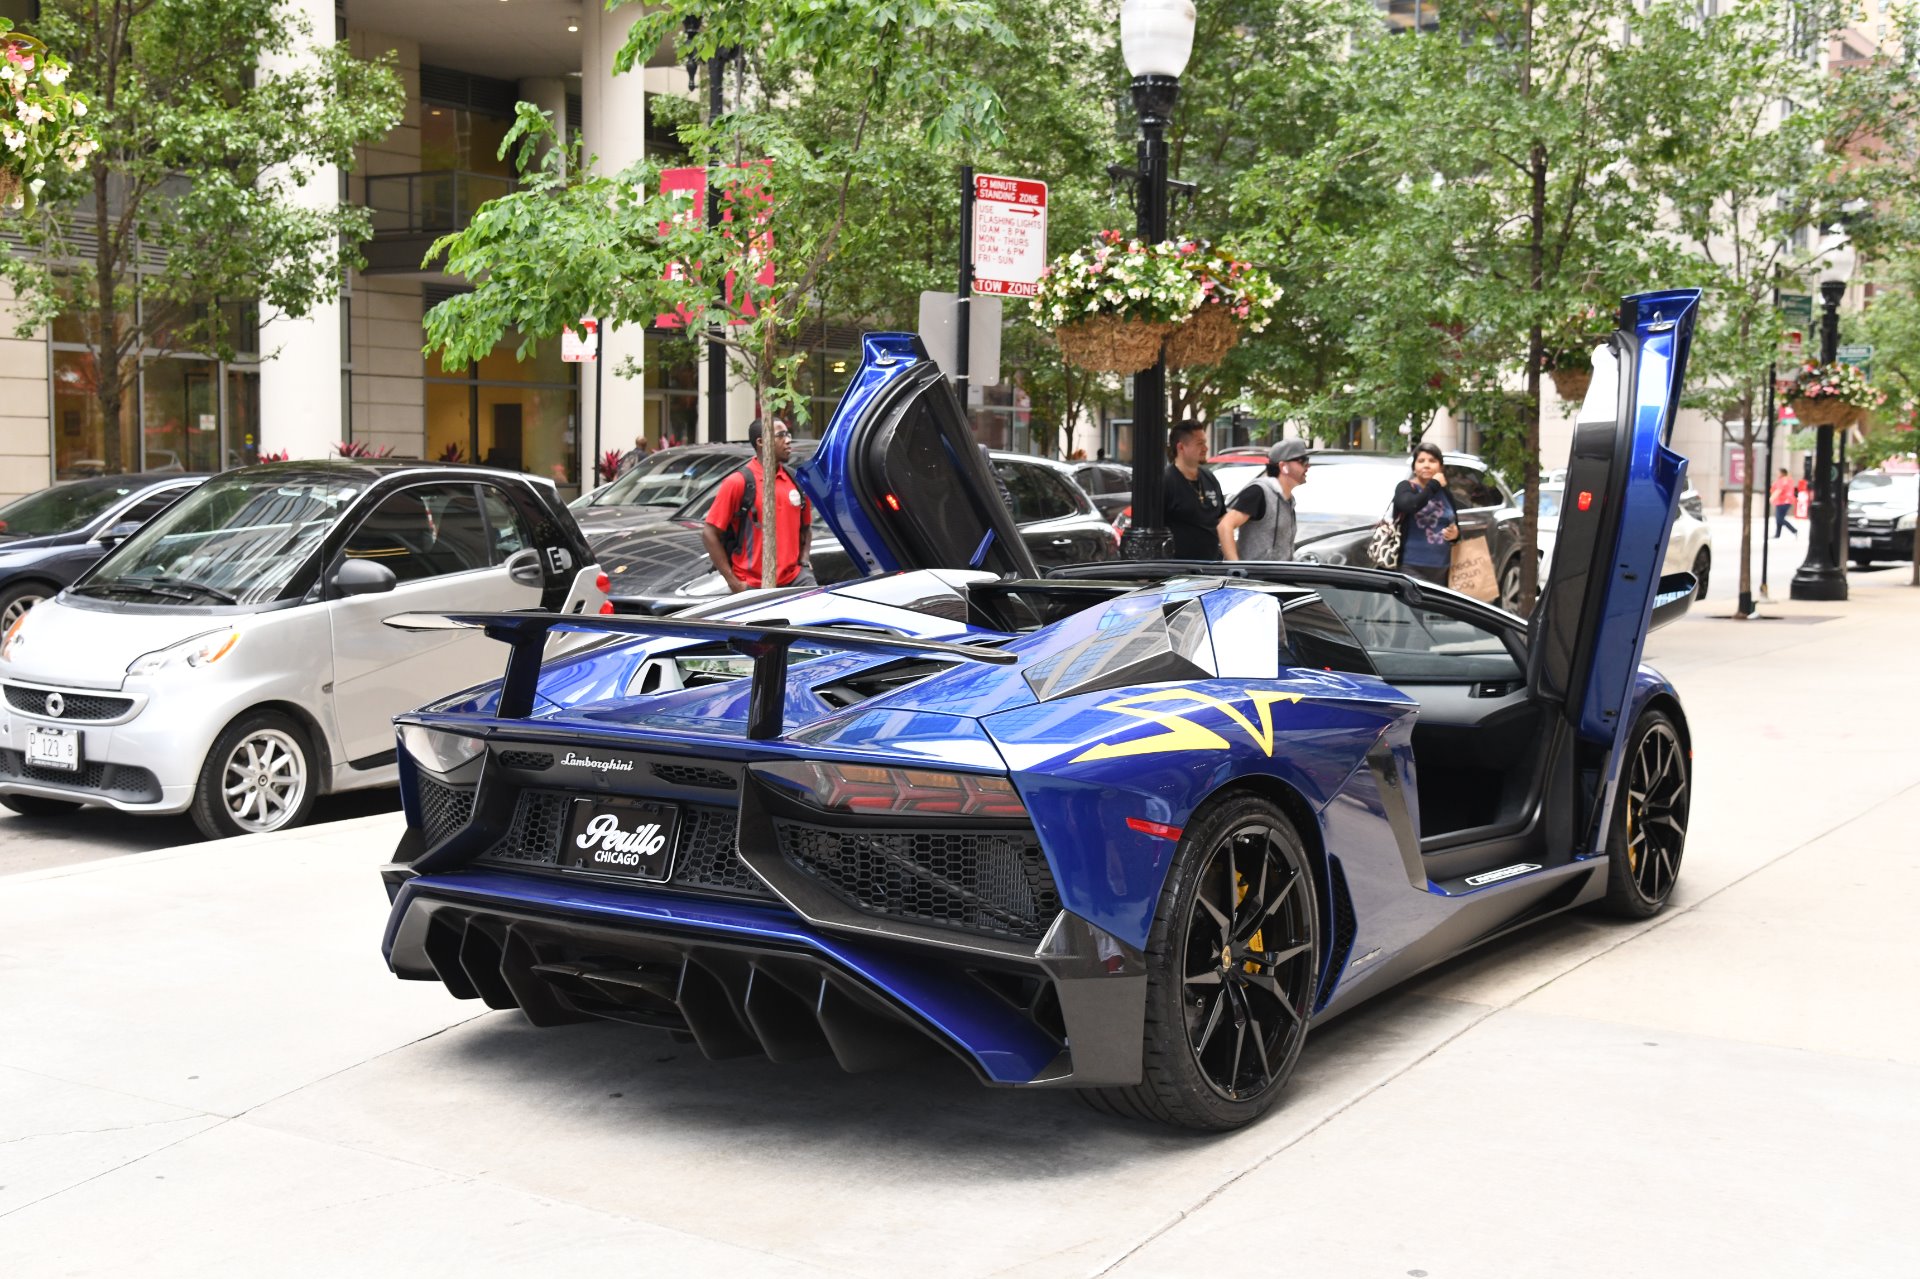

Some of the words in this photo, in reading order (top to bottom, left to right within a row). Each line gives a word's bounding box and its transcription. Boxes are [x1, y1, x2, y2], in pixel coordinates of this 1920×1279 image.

[979, 179, 988, 188] 15
[989, 180, 1018, 192] MINUTE
[979, 189, 1017, 202] STANDING
[1019, 193, 1040, 205] ZONE
[978, 205, 994, 214] USE
[978, 215, 1015, 227] FLASHING
[1016, 219, 1042, 230] LIGHTS
[978, 225, 987, 233] 10
[988, 226, 1000, 234] AM
[1014, 229, 1026, 237] PM
[978, 235, 995, 244] MON
[1003, 237, 1030, 248] THURS
[978, 245, 987, 253] 10
[987, 246, 999, 254] AM
[1013, 248, 1025, 257] PM
[977, 254, 991, 263] FRI
[997, 256, 1014, 265] SUN
[977, 279, 1002, 293] TOW
[1007, 283, 1038, 296] ZONE
[42, 738, 59, 758] 123
[560, 752, 634, 772] Lamborghini
[576, 813, 666, 856] Perillo
[594, 850, 640, 866] CHICAGO
